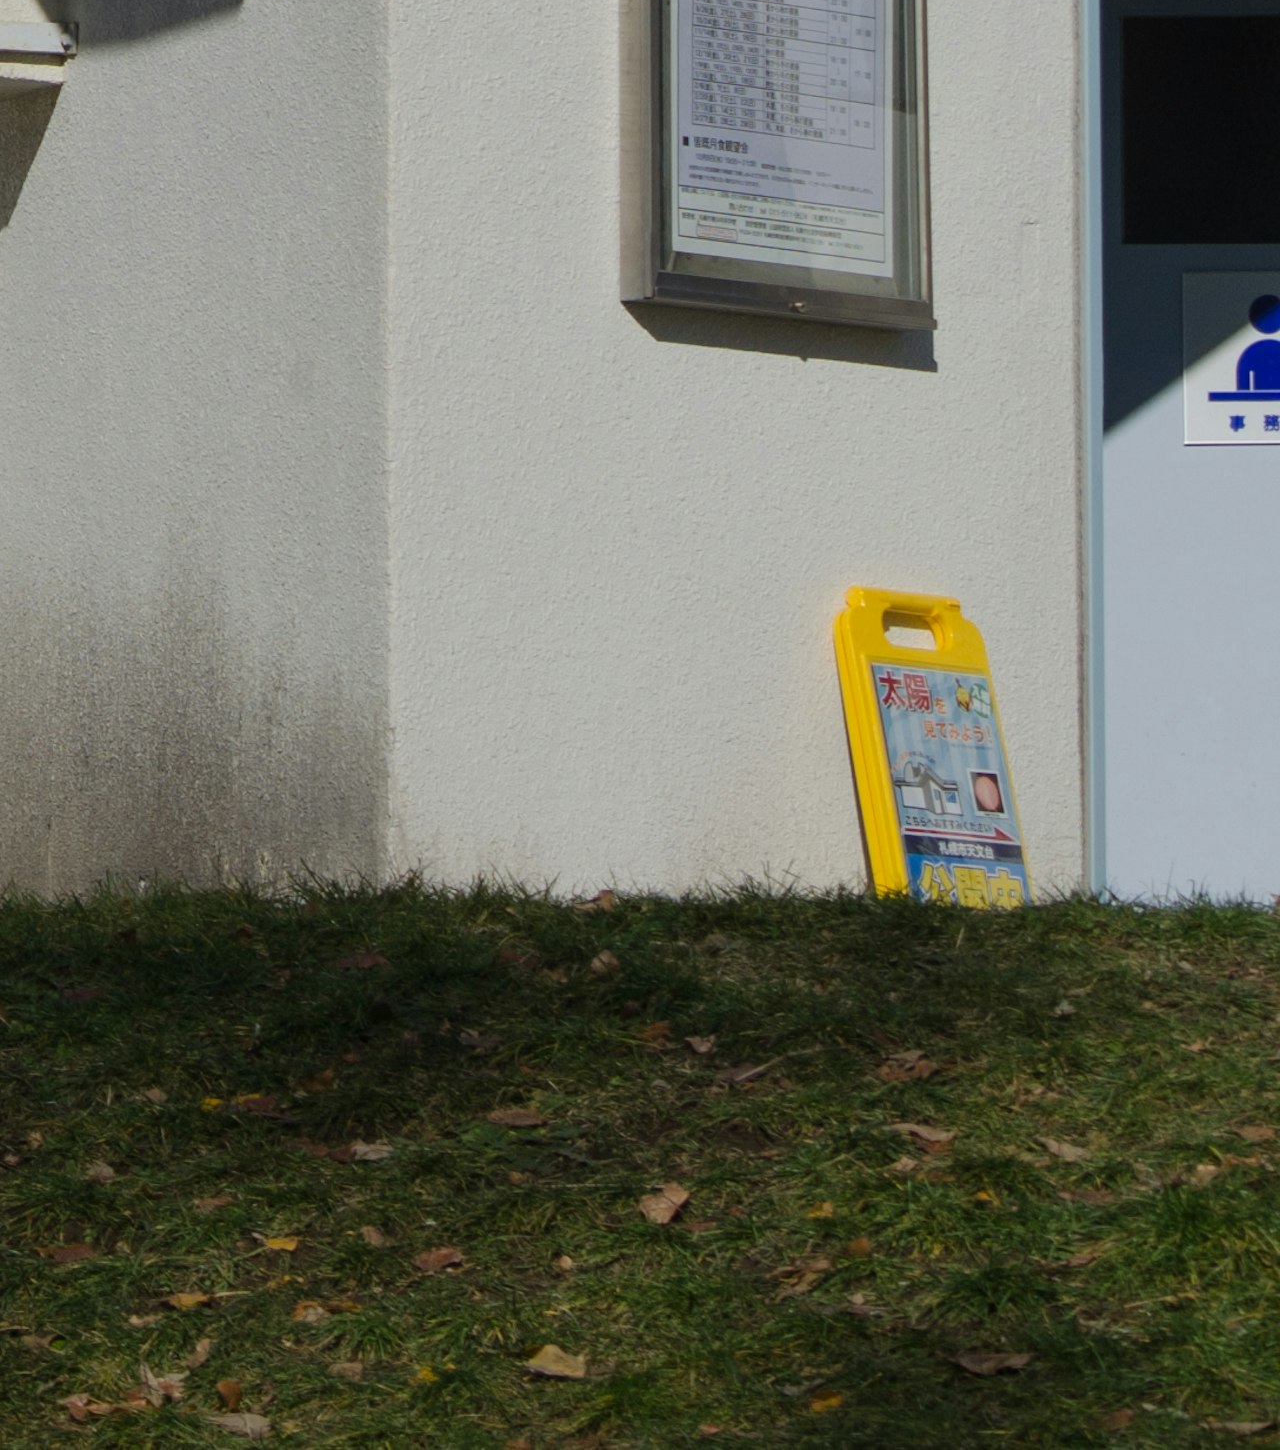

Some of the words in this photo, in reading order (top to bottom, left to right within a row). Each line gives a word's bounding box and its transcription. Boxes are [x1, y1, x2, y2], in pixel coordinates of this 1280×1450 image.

[938, 840, 995, 860] 札幌市天文台
[919, 861, 1024, 910] 公開中
